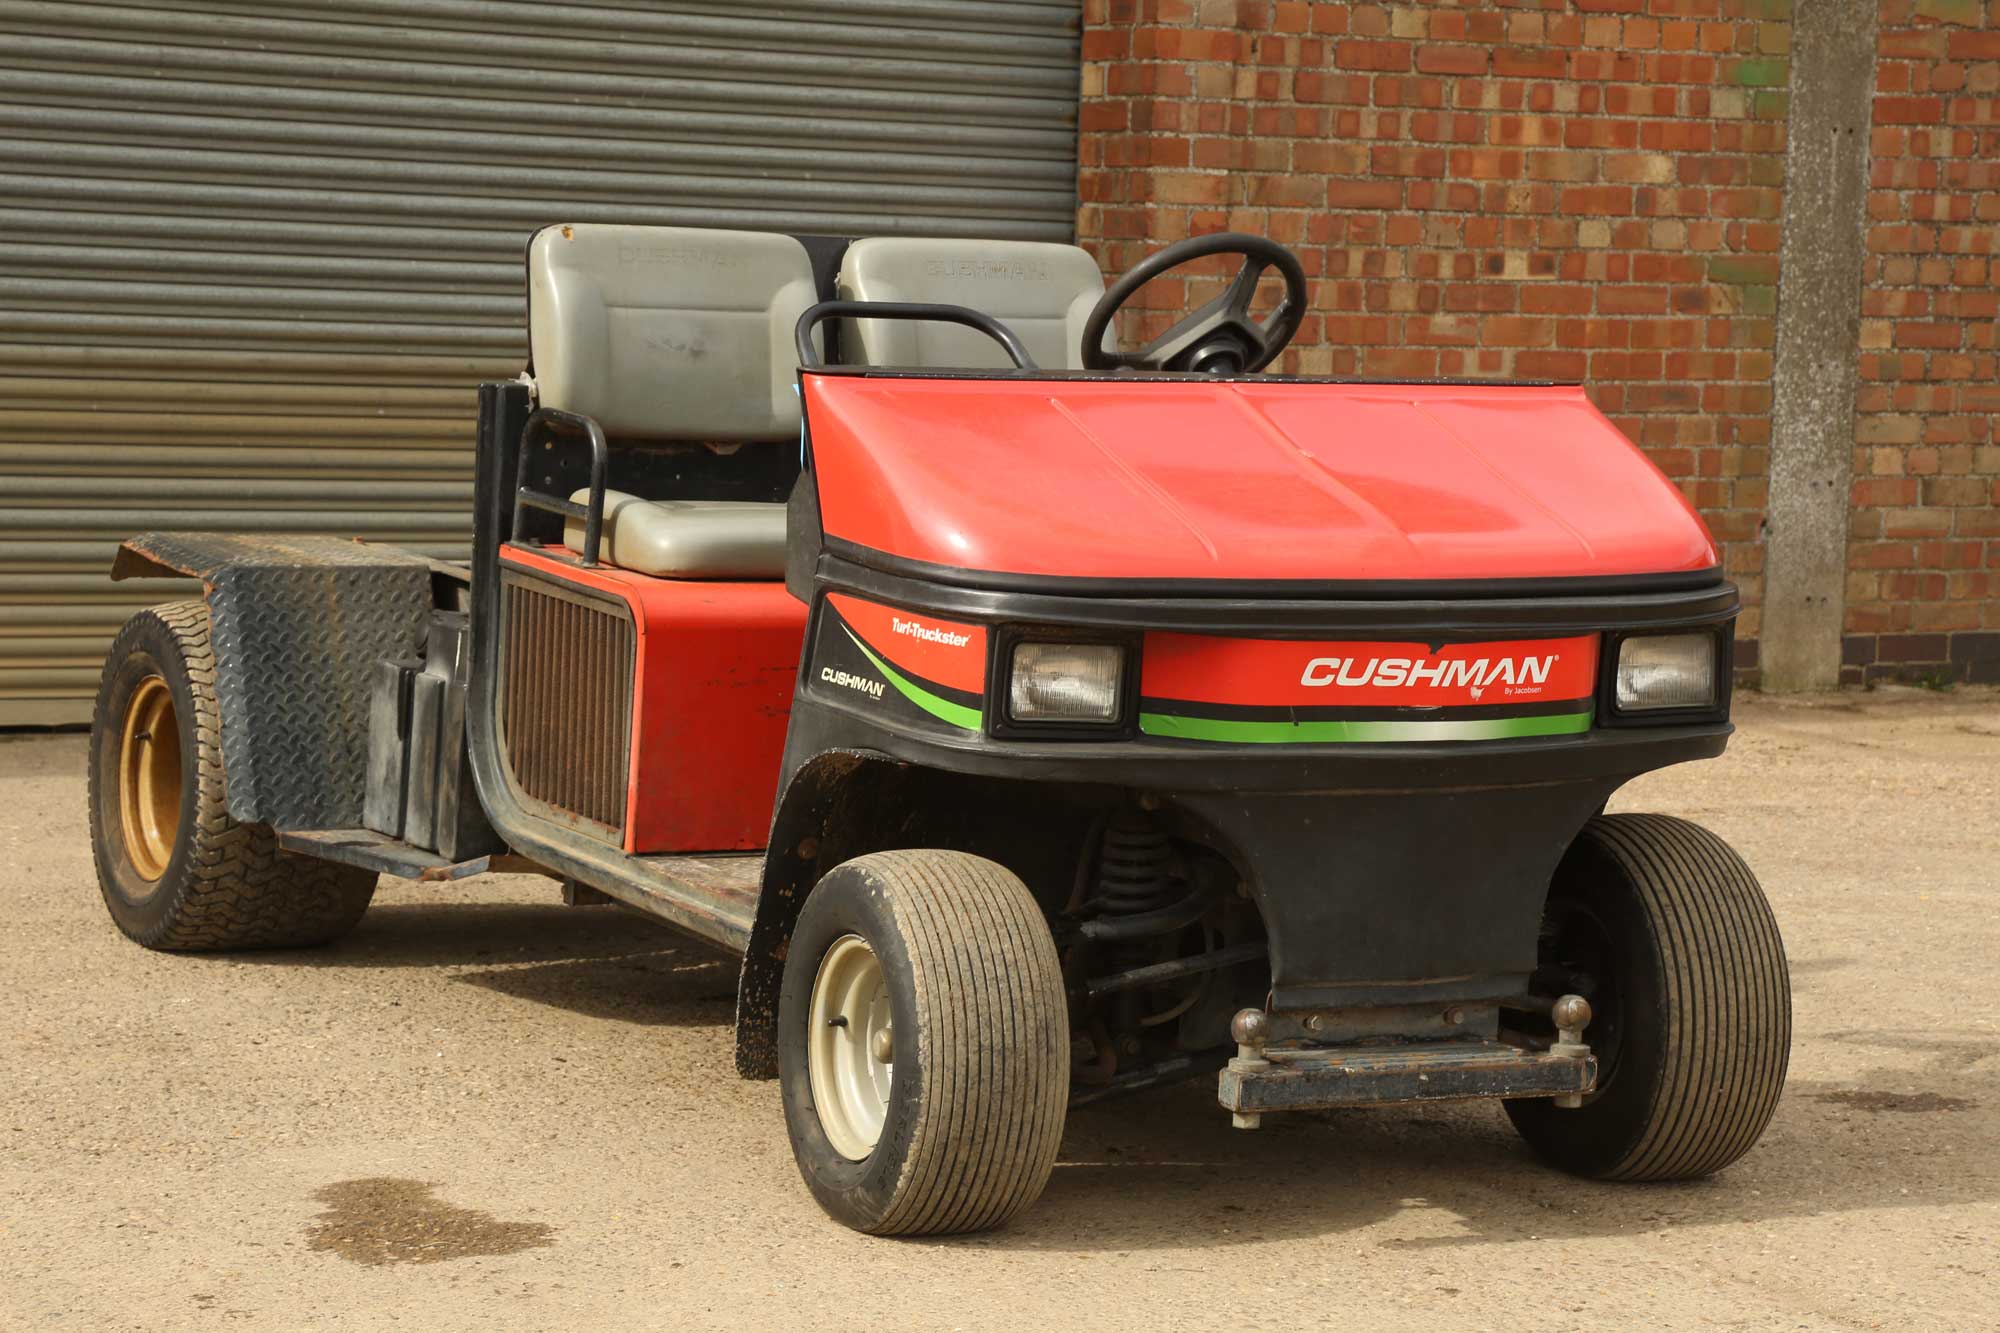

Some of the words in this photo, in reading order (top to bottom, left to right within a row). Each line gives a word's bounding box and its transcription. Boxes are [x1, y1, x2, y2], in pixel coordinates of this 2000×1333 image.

[892, 618, 969, 648] Turf-Truckster
[821, 667, 885, 697] CUSHMAN
[1300, 656, 1553, 688] CUSHMAN
[1504, 687, 1513, 696] By
[1514, 686, 1542, 695] Jacobsen
